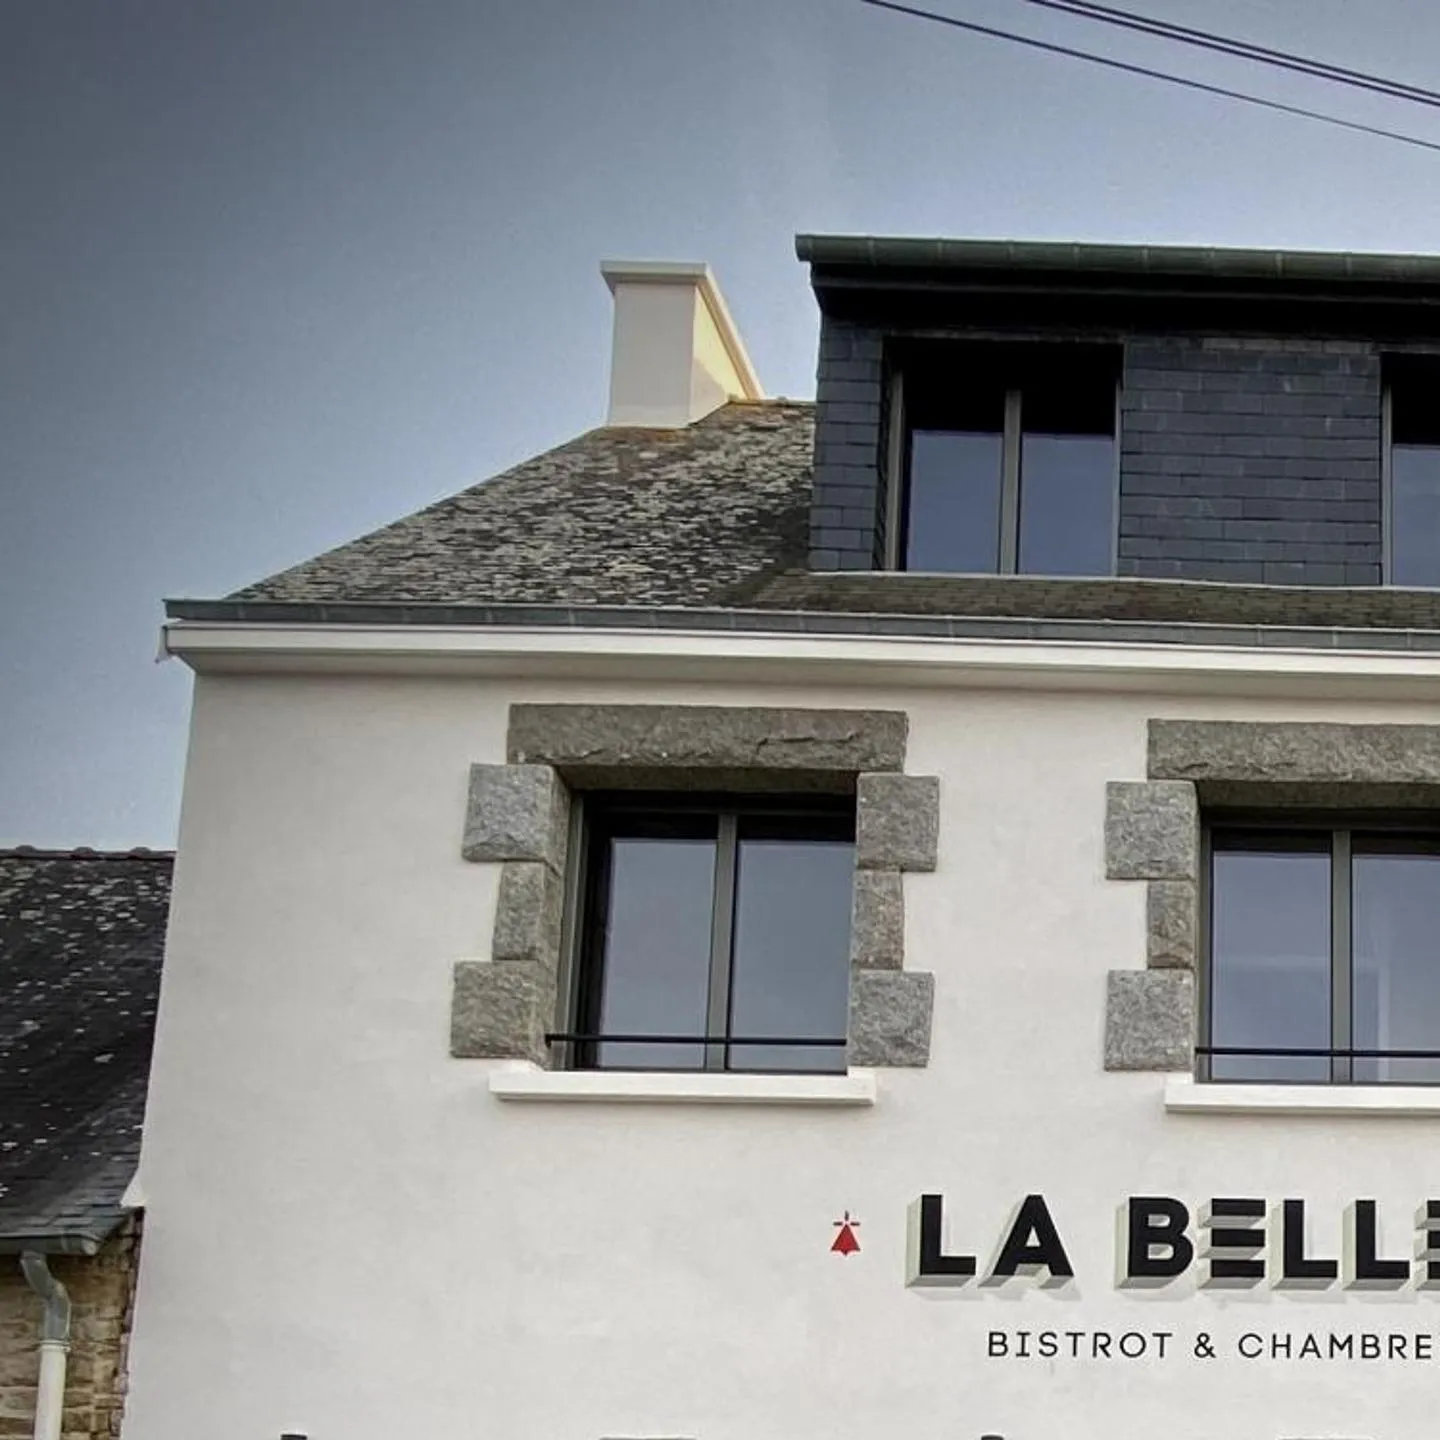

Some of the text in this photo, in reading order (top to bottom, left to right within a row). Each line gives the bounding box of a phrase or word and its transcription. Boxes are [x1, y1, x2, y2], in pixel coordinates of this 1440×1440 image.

[916, 1194, 1074, 1280] LA
[987, 1331, 1173, 1359] BISTROT
[1193, 1332, 1216, 1360] &
